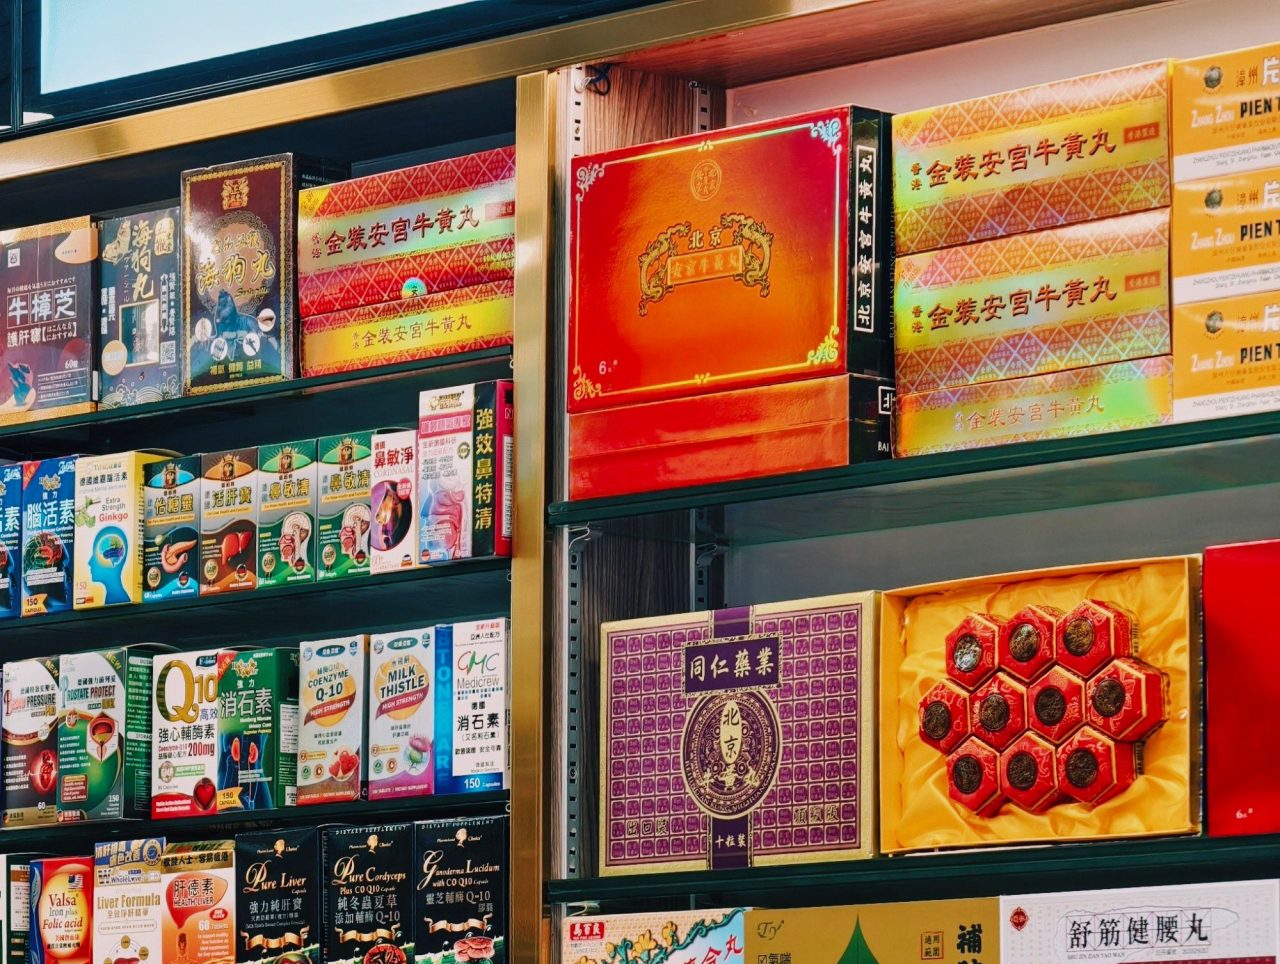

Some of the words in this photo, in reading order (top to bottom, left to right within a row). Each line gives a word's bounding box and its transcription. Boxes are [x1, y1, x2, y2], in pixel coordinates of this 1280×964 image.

[1240, 96, 1273, 119] PIEN
[689, 229, 721, 250] 北京
[1240, 219, 1273, 242] PIEN
[1240, 343, 1273, 365] PIEN
[105, 497, 121, 505] Extra
[99, 512, 129, 523] Ginkgo
[27, 598, 38, 606] 150
[690, 646, 774, 682] 同仁藥業
[308, 669, 349, 689] COENZYME
[387, 667, 416, 682] MILK
[315, 681, 344, 702] Q-10
[379, 674, 425, 699] THISTLE
[457, 713, 500, 732] 消石素
[724, 707, 740, 759] 北京
[188, 741, 215, 758] 200mg
[243, 860, 277, 894] Pure
[280, 875, 306, 889] Liver
[333, 854, 364, 891] Pure
[366, 867, 406, 883] Cordyceps
[465, 861, 500, 875] Lucidum
[340, 886, 354, 894] Plus
[458, 878, 473, 887] Q10
[49, 893, 77, 908] Valsa
[97, 896, 119, 909] Liver
[122, 893, 160, 906] Formula
[43, 917, 64, 930] Folic
[66, 916, 83, 928] acid
[1070, 912, 1208, 949] 舒筋健腰丸
